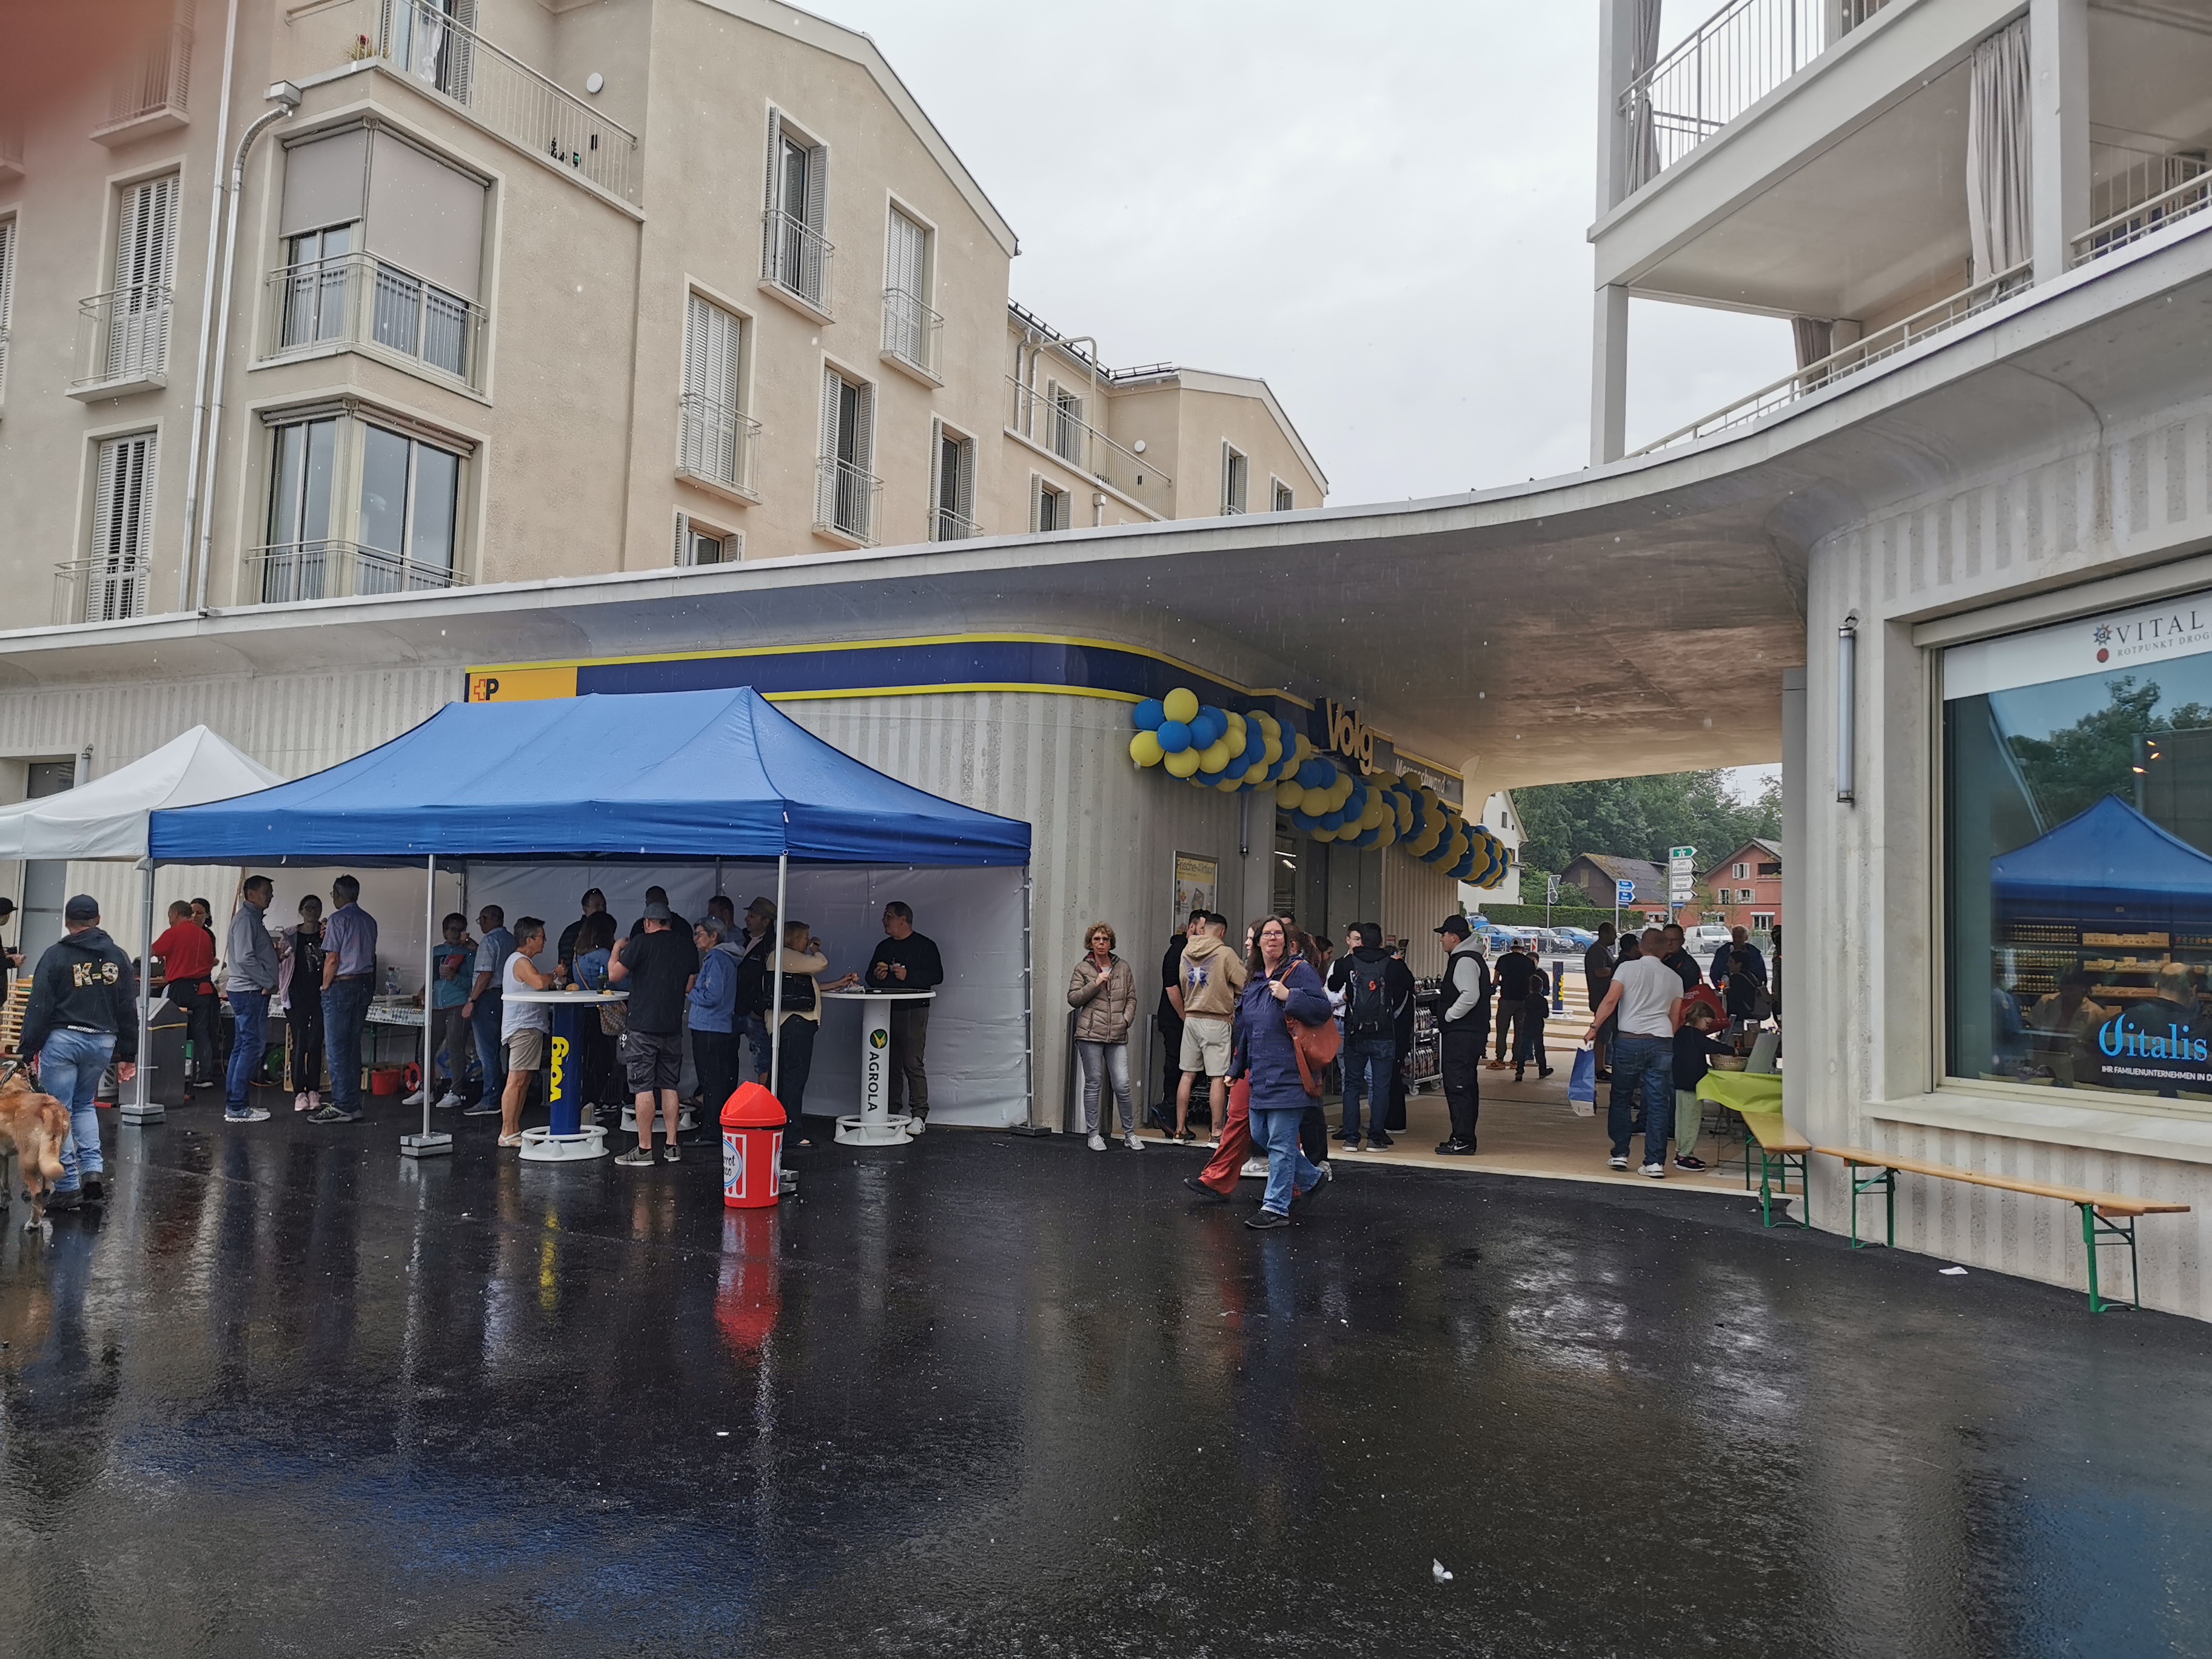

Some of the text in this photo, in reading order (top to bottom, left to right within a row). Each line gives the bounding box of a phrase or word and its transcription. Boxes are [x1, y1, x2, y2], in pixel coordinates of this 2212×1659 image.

[2116, 610, 2204, 644] VITAL
[2117, 631, 2212, 657] ROTPUNKT DROG
[1326, 697, 1374, 776] Volg
[73, 962, 119, 987] K-9
[2099, 1013, 2208, 1061] Vitalis
[868, 1051, 880, 1112] AGROLA
[2114, 1066, 2196, 1081] FAMILIENUNTERNEHMEN
[2206, 1073, 2212, 1082] D
